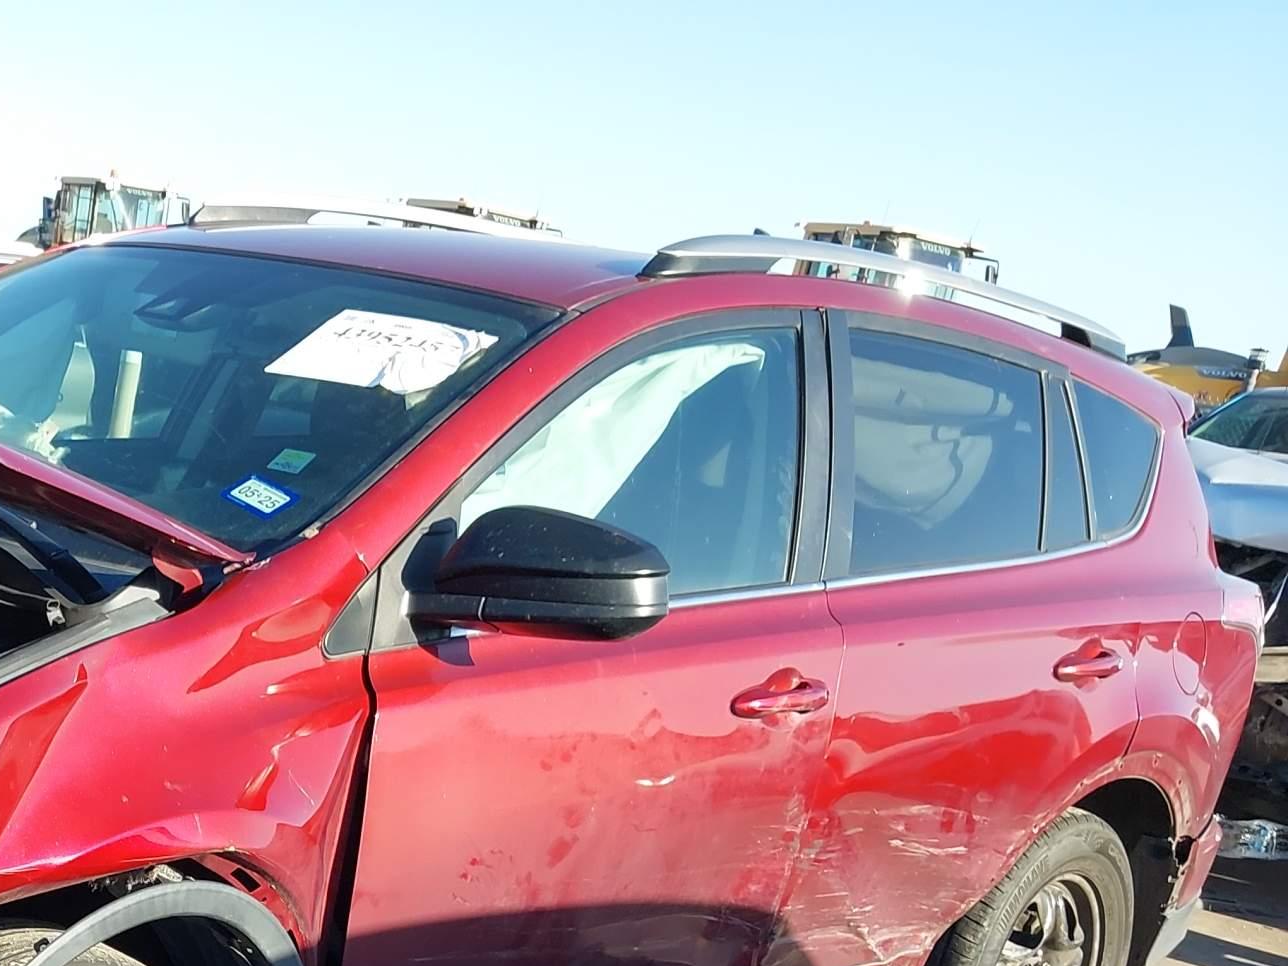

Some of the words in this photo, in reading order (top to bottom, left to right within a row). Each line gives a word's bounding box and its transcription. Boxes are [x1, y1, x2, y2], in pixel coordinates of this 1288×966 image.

[492, 214, 521, 227] VOLVO
[920, 241, 951, 257] VOLVO
[1201, 366, 1248, 379] VOLVO
[237, 485, 259, 499] 05
[256, 494, 281, 510] 25
